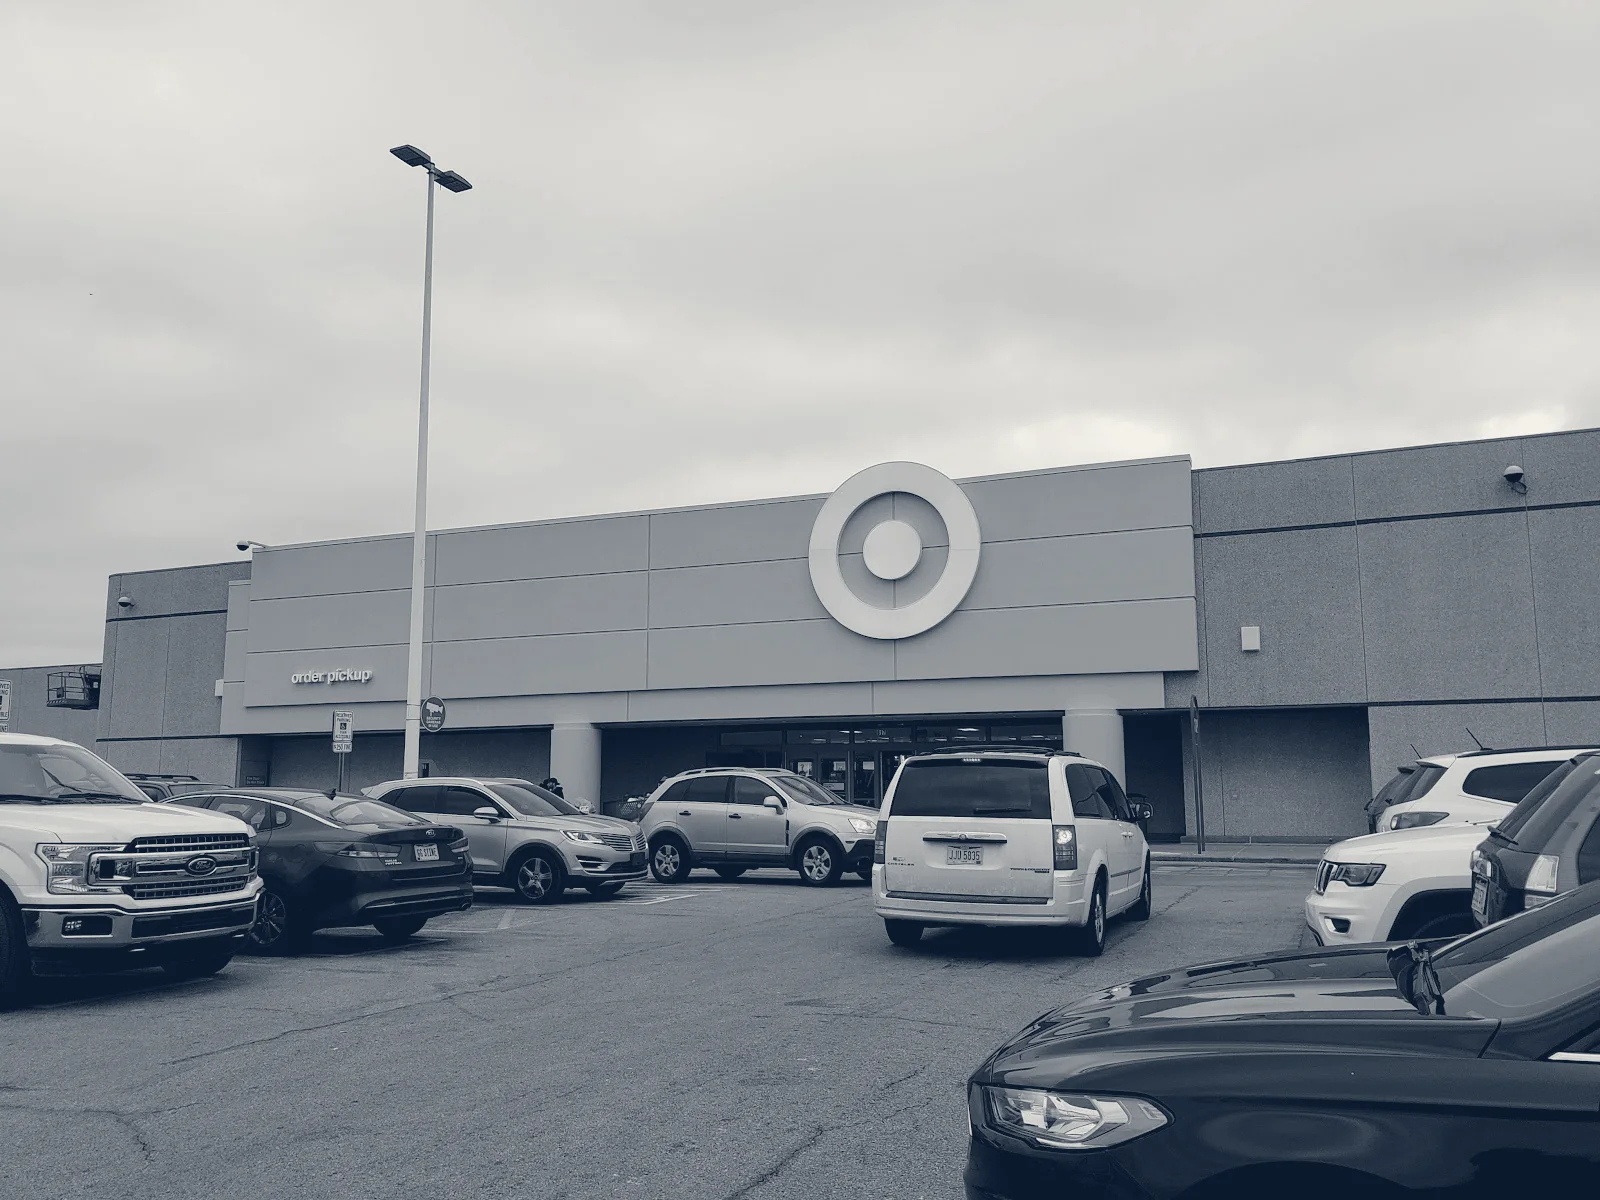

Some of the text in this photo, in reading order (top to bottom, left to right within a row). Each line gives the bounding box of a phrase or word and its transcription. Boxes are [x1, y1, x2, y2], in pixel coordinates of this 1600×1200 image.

[291, 667, 373, 685] order pickup
[963, 850, 981, 861] 5835
[196, 861, 211, 870] Ford
